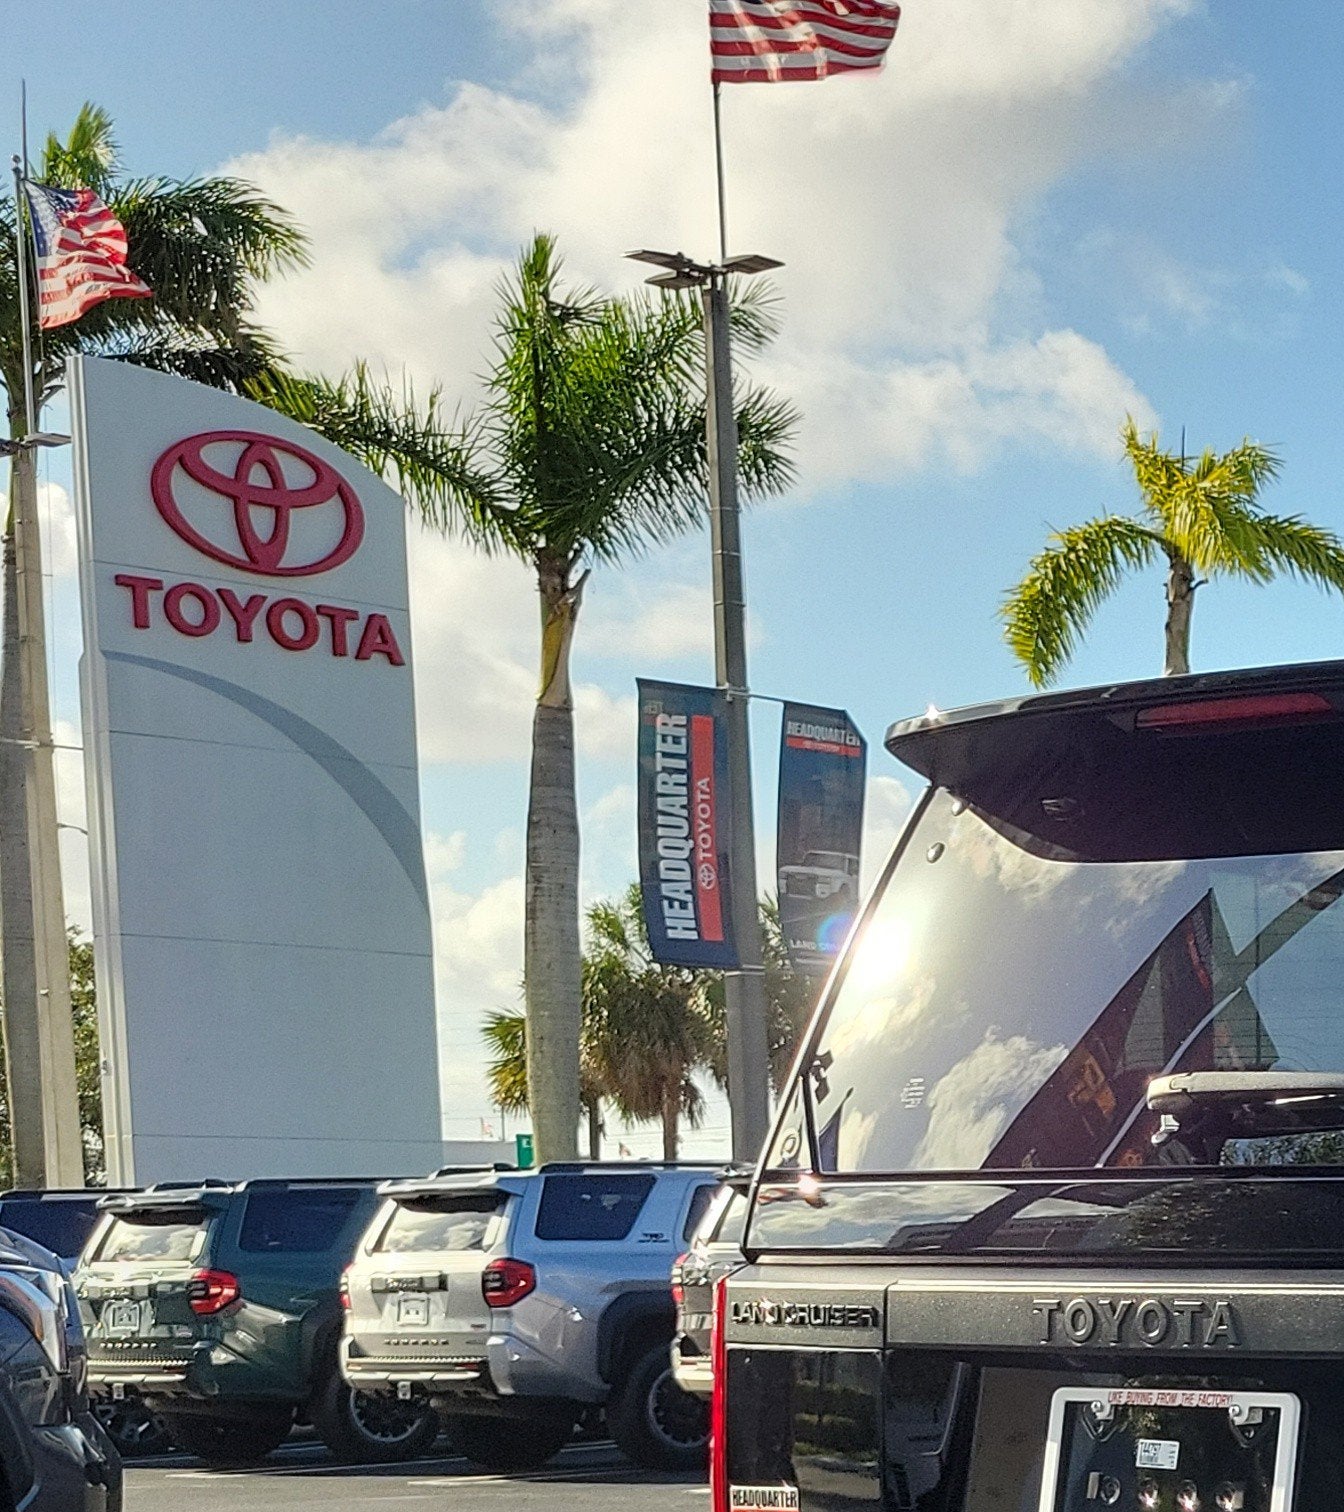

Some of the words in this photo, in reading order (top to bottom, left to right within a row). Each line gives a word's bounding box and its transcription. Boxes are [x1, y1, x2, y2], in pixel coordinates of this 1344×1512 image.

[115, 574, 405, 666] TOYOTA
[656, 713, 699, 940] HEADQUARTER
[697, 777, 713, 861] TOYOTA
[731, 1300, 781, 1326] LAND
[782, 1301, 880, 1329] CRUISER
[1033, 1298, 1241, 1348] TOYOTA
[732, 1489, 797, 1509] HEADQUARTER
